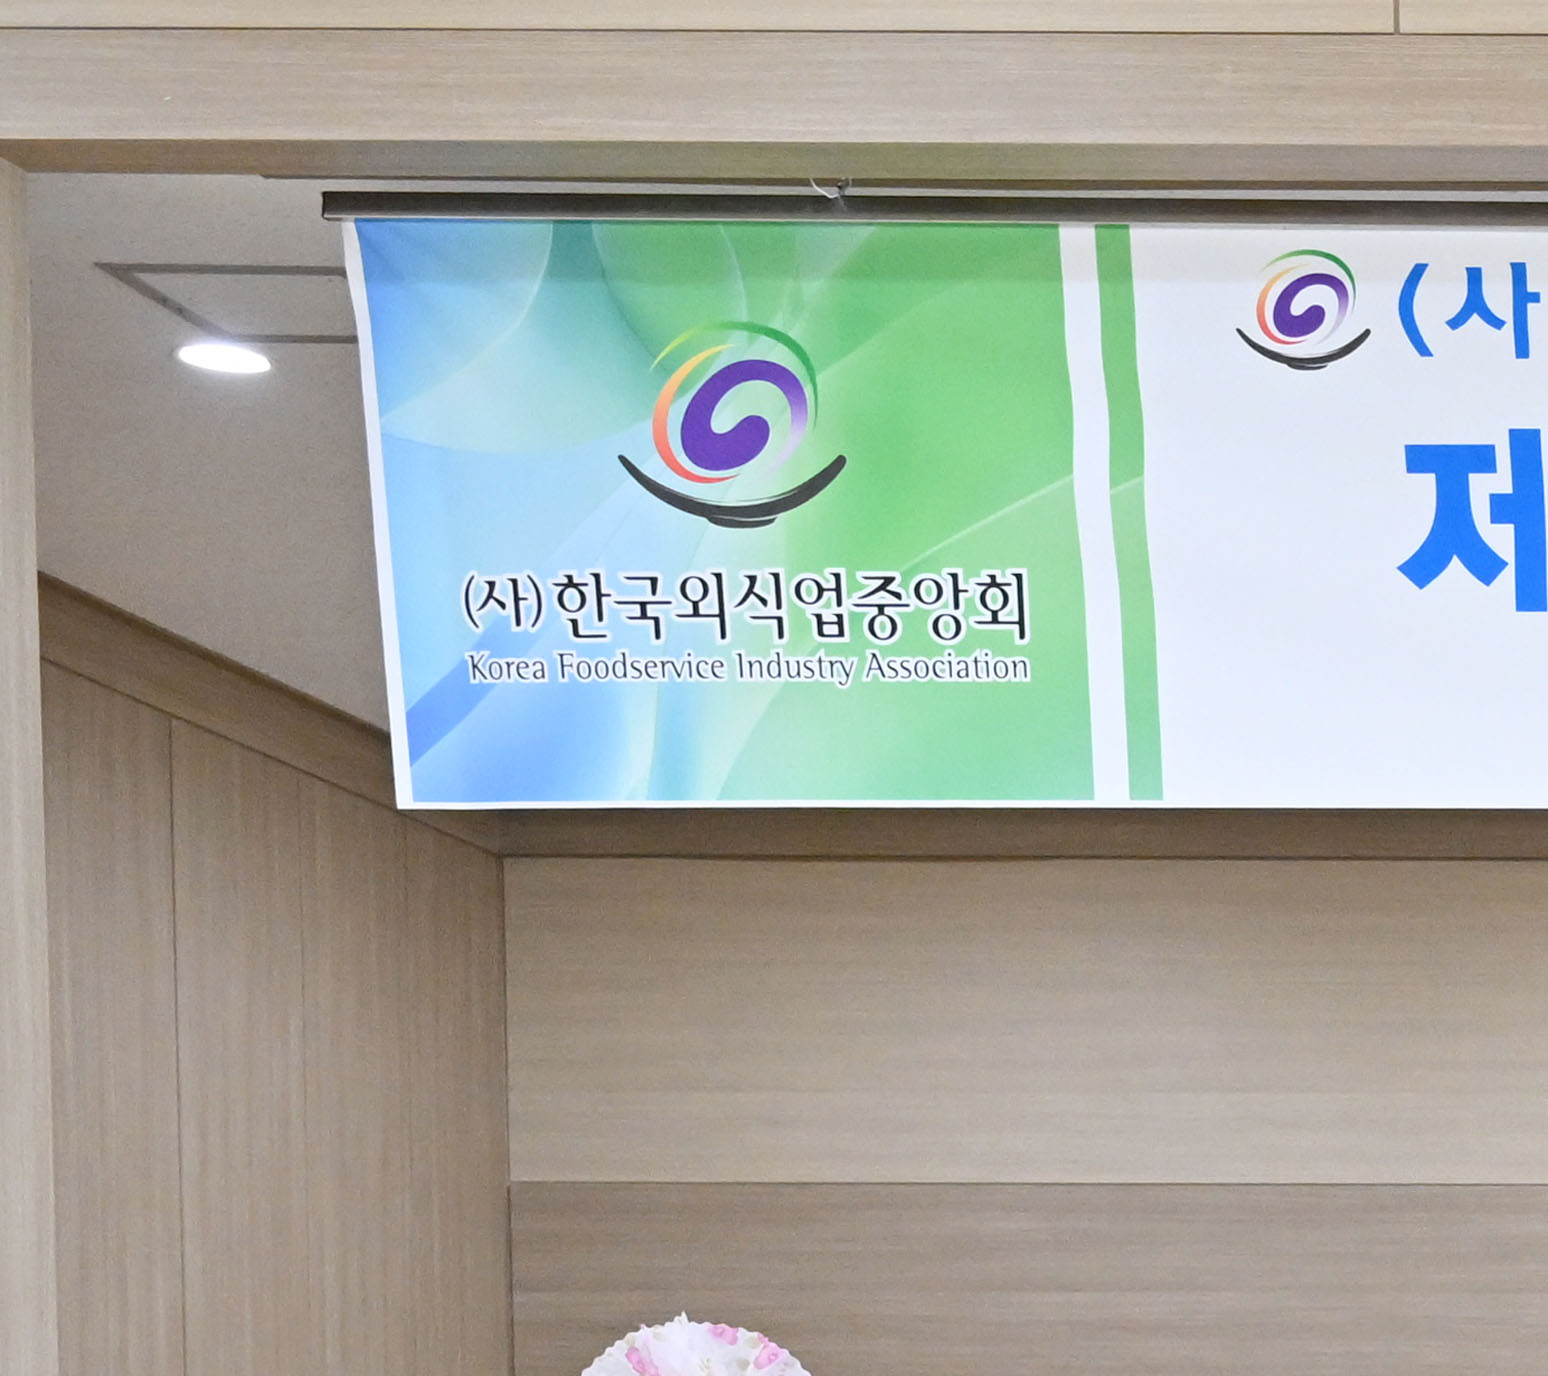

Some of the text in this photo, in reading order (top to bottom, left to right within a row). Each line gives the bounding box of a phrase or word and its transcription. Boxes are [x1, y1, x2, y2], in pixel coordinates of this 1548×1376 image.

[462, 570, 1028, 642] (사)한국외식업중앙회
[468, 652, 1030, 686] Korea Foodservice Industry Association
